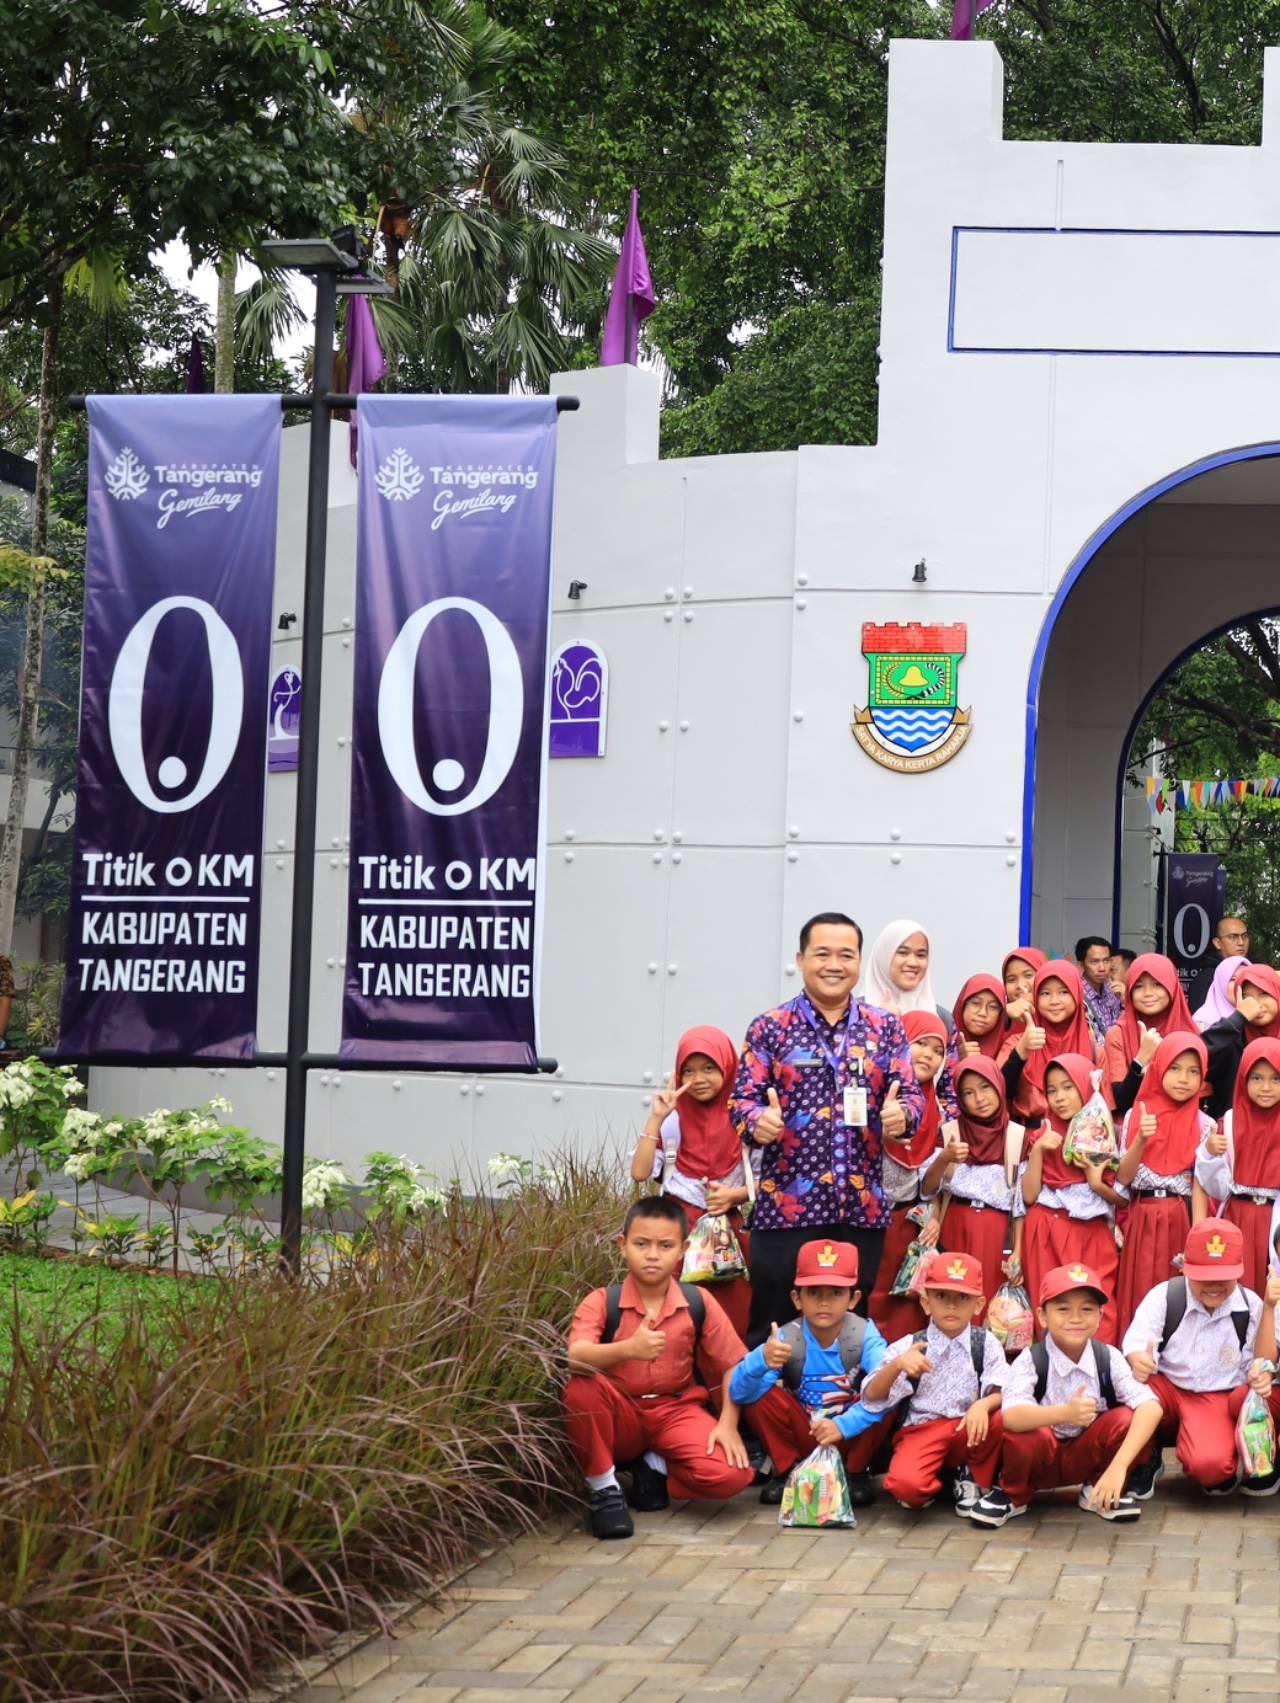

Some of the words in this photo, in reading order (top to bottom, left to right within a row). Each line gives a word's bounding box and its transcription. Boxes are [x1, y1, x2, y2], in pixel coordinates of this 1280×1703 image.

[154, 465, 263, 488] Tangerang
[170, 463, 260, 471] KABUPATEN
[429, 466, 539, 489] Tangerang
[156, 487, 243, 530] Gemilang
[430, 488, 517, 530] Gemilang
[856, 726, 876, 754] SATYA
[874, 750, 904, 769] KARYA
[905, 756, 936, 769] KERTA
[935, 726, 968, 762] RAHARJA
[83, 853, 155, 887] Titik
[198, 854, 255, 887] KM
[359, 855, 435, 890] Titik
[480, 858, 536, 891] KM
[83, 912, 247, 946] KABUPATEN
[361, 915, 530, 950] KABUPATEN
[79, 958, 246, 993] TANGERANG
[358, 962, 530, 998] TANGERANG
